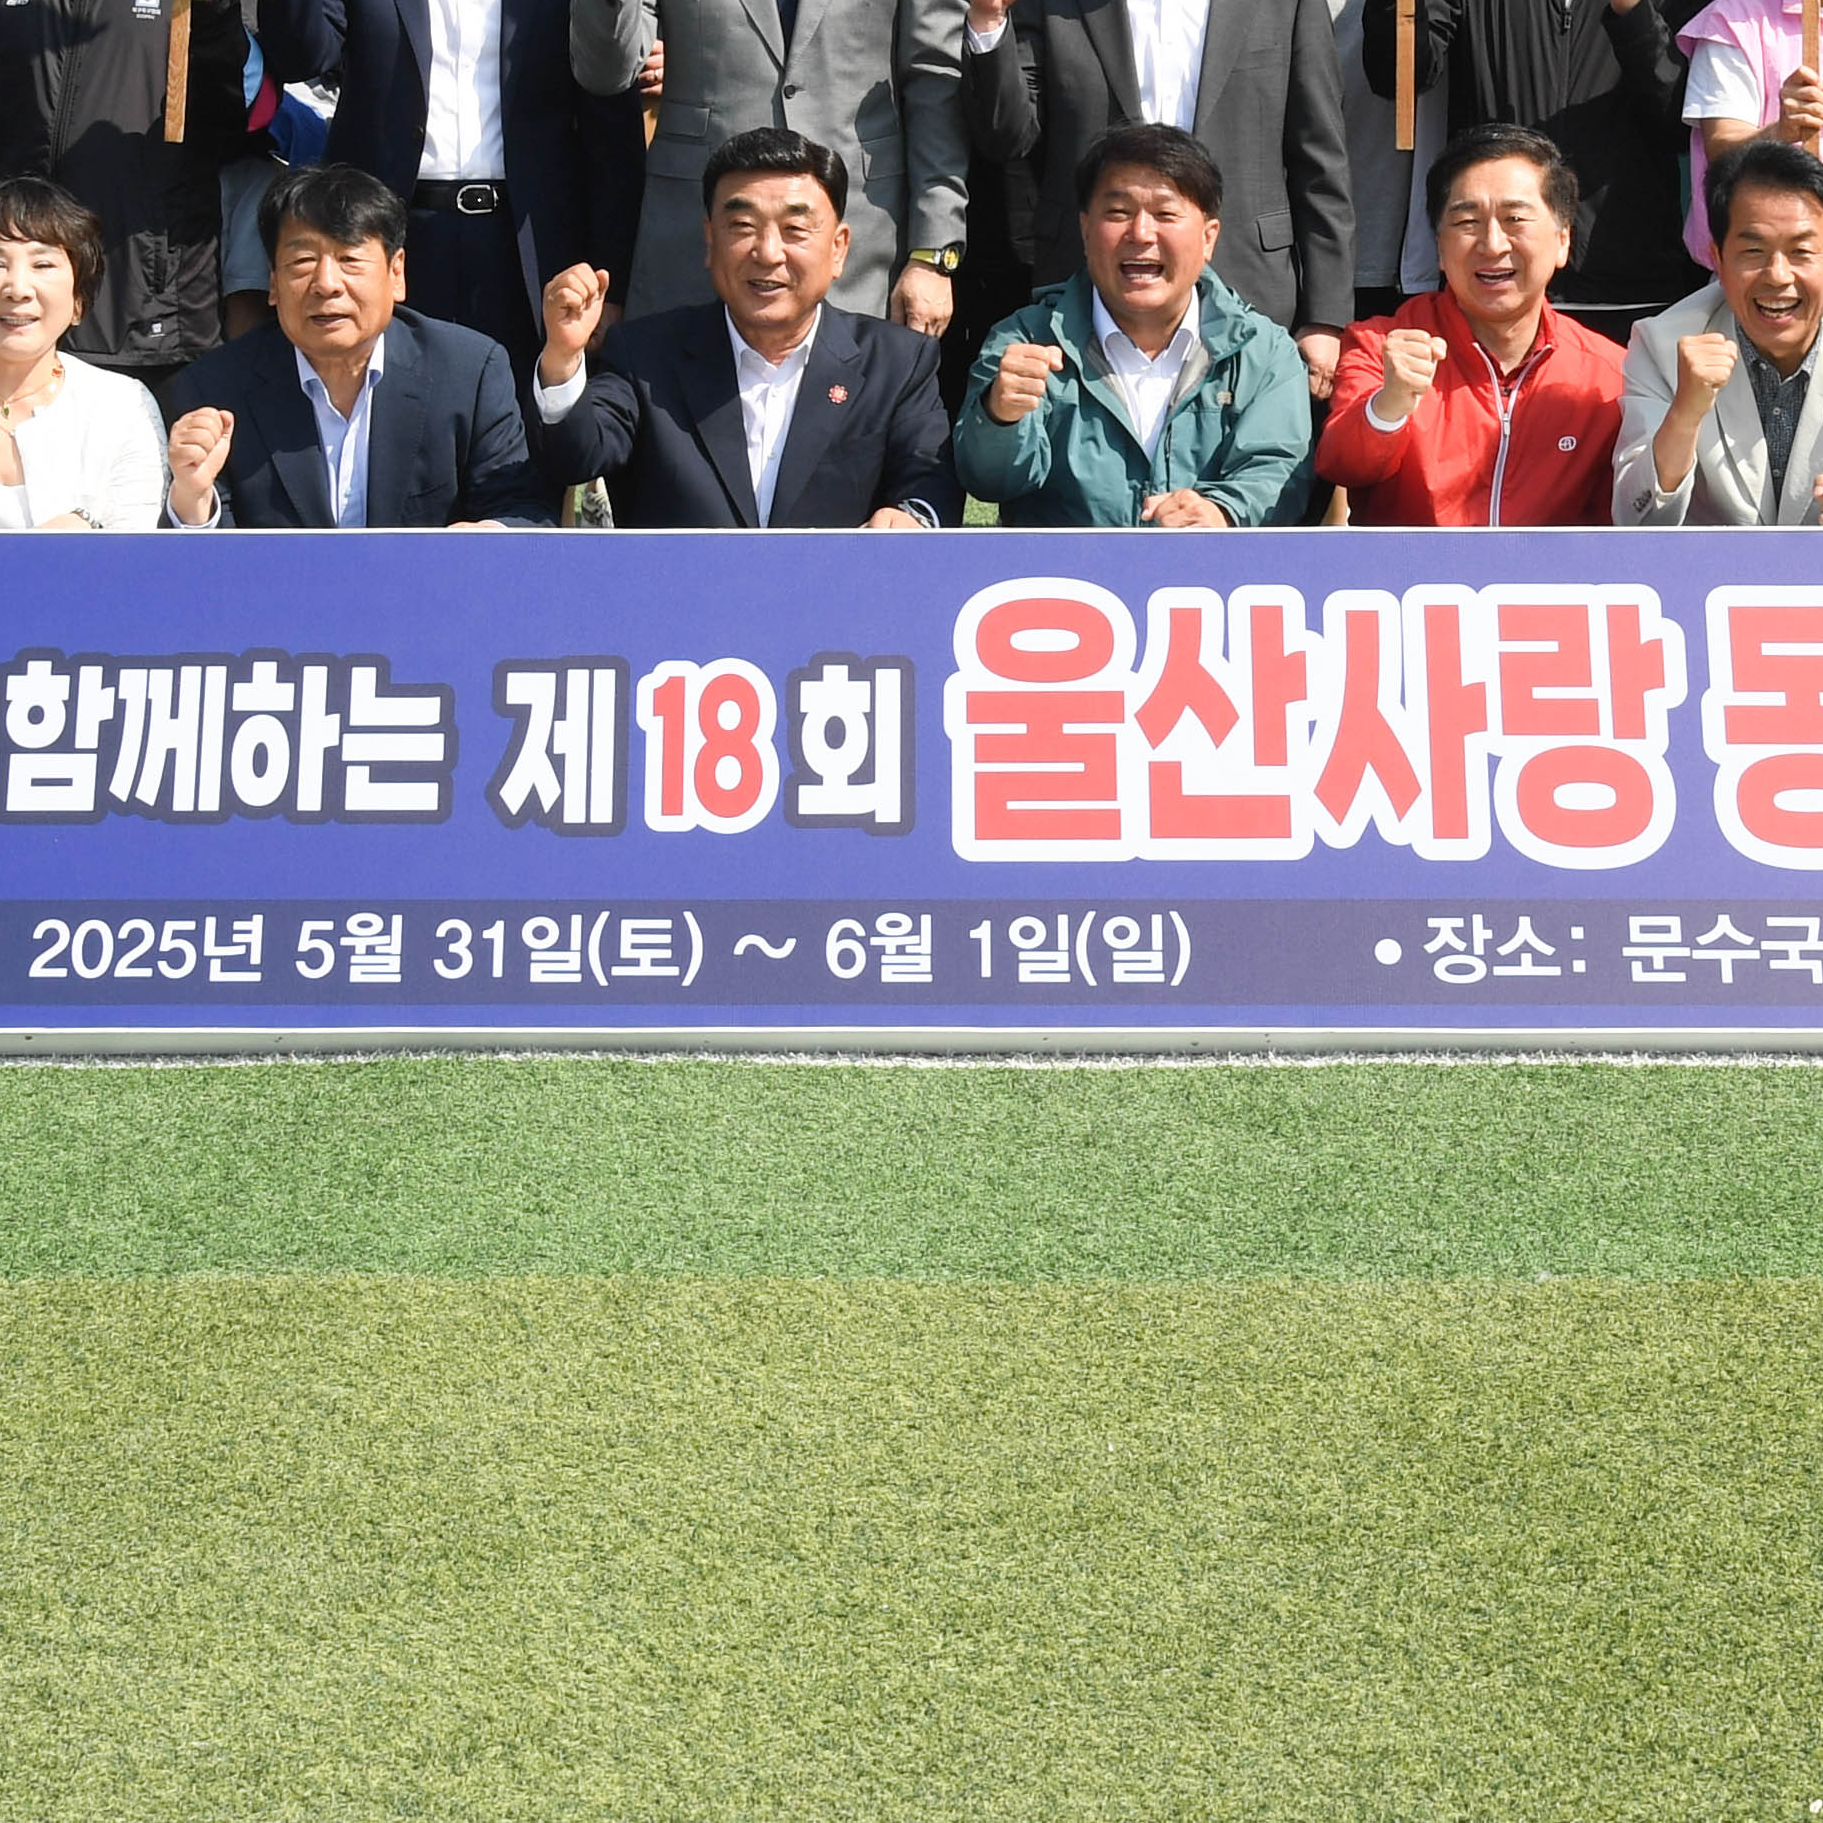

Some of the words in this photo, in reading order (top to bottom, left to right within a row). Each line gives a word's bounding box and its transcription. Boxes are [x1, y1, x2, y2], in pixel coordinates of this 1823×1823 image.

[7, 661, 444, 811] 함께하는
[968, 599, 1664, 846] 울산사랑
[30, 915, 263, 981] 2025년
[296, 913, 402, 982] 5월
[434, 912, 702, 986] 31일(토)
[826, 913, 932, 982] 6월
[970, 911, 1190, 986] 1일(일)
[1424, 914, 1585, 983] 장소:
